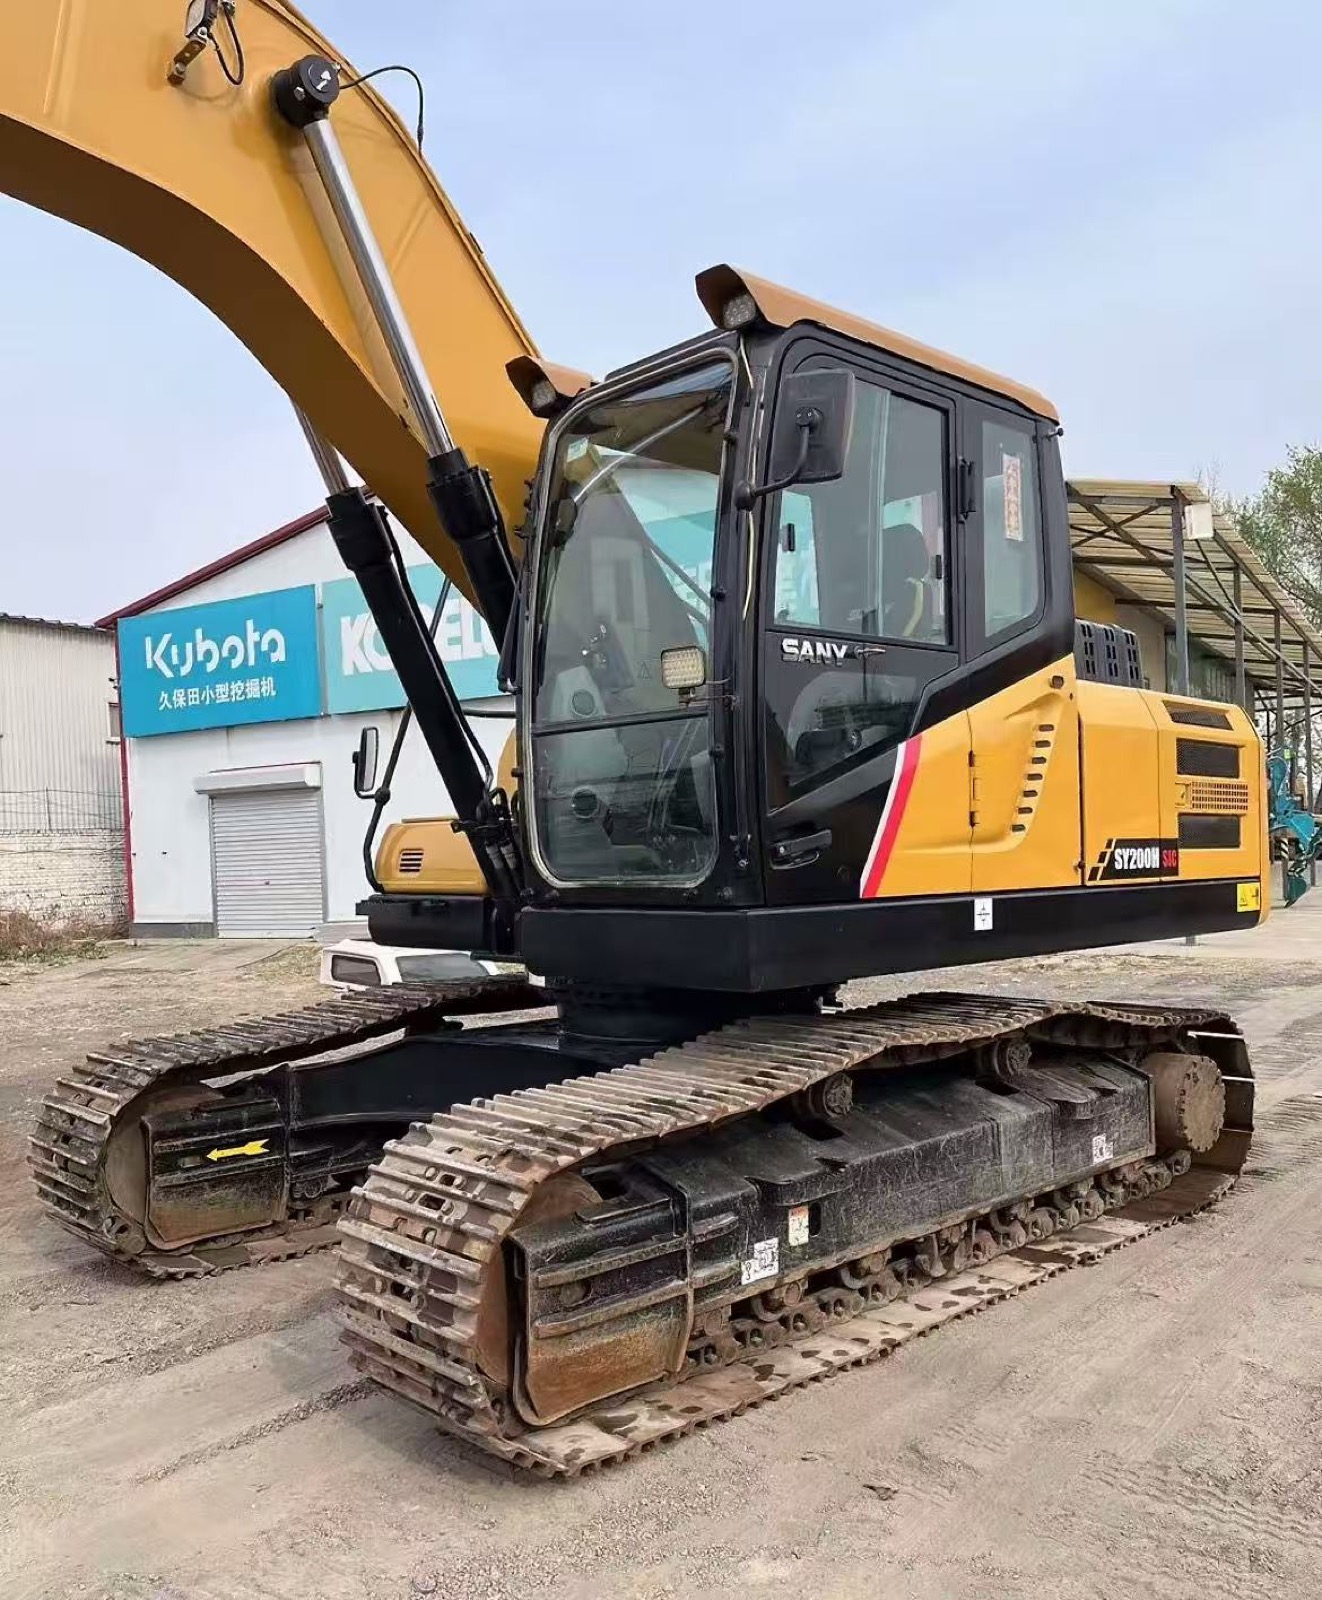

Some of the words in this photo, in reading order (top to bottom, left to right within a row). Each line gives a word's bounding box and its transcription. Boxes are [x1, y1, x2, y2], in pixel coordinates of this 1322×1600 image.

[145, 618, 286, 678] Kubota
[782, 638, 849, 665] SANY
[158, 676, 277, 710] 久保田小型挖掘机
[1114, 846, 1160, 870] SY200H
